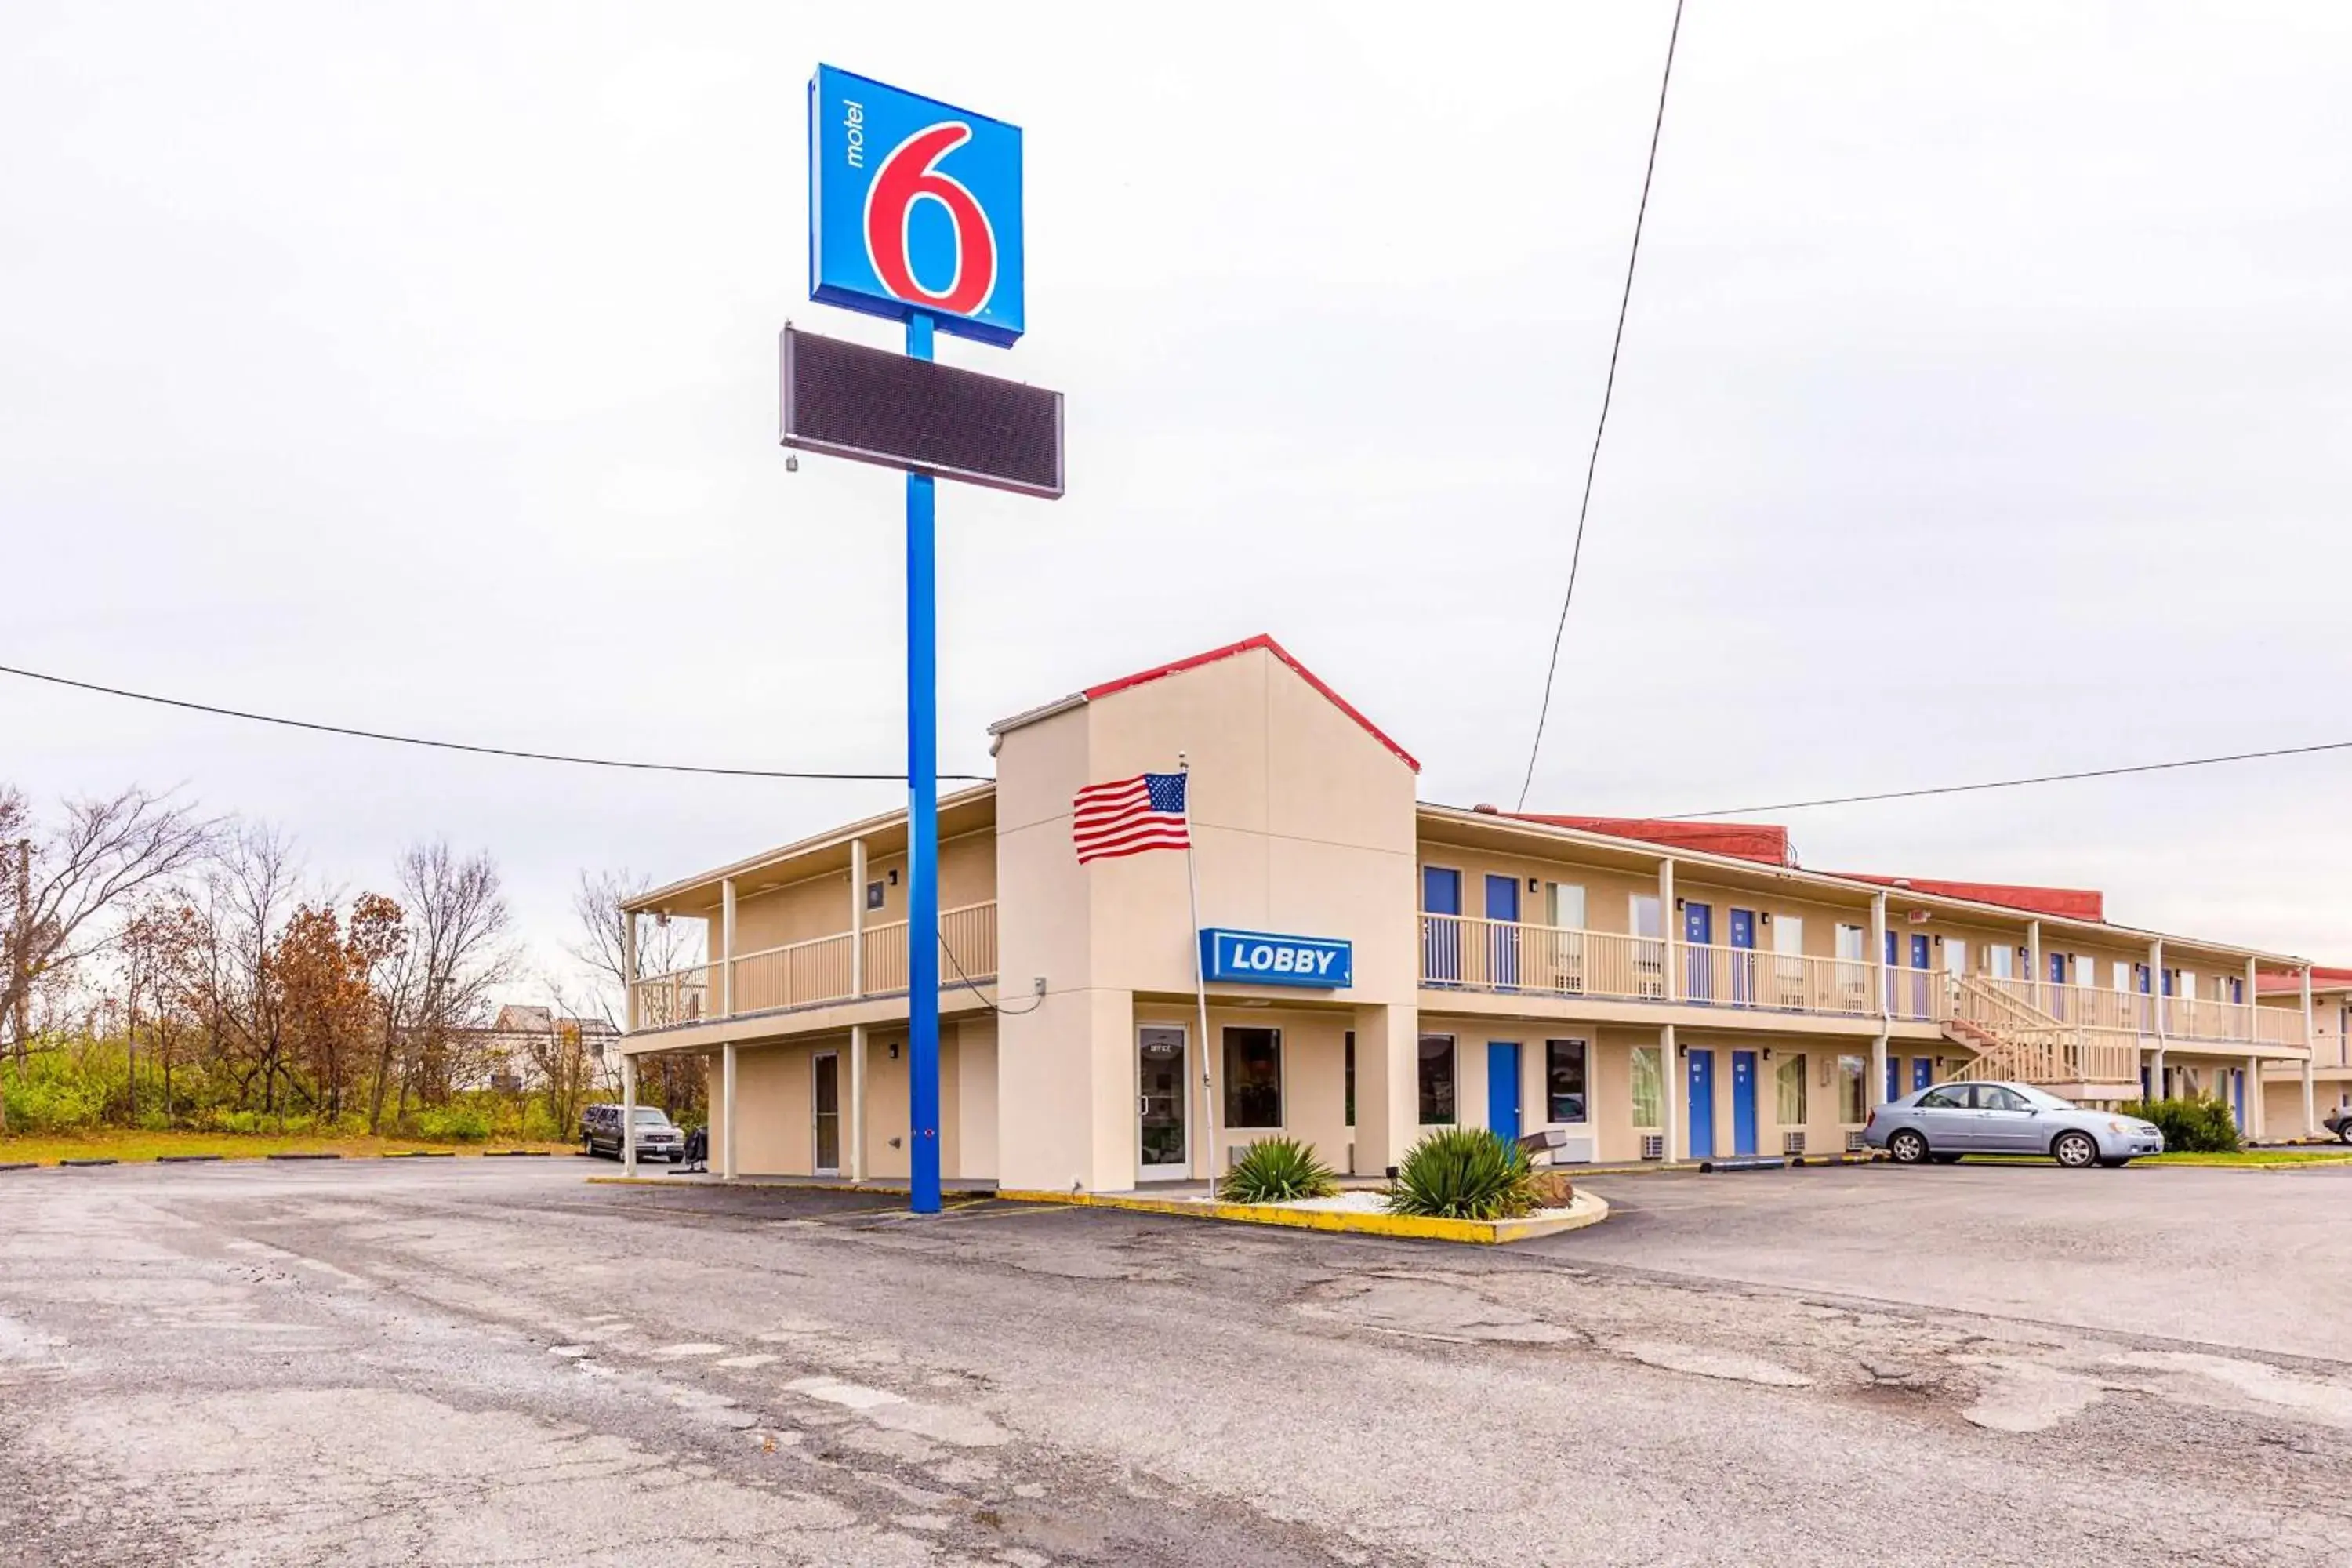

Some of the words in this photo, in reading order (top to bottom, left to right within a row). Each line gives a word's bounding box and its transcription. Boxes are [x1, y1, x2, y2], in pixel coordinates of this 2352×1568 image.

[843, 100, 863, 168] motel
[864, 120, 997, 317] 6
[1232, 943, 1337, 975] LOBBY
